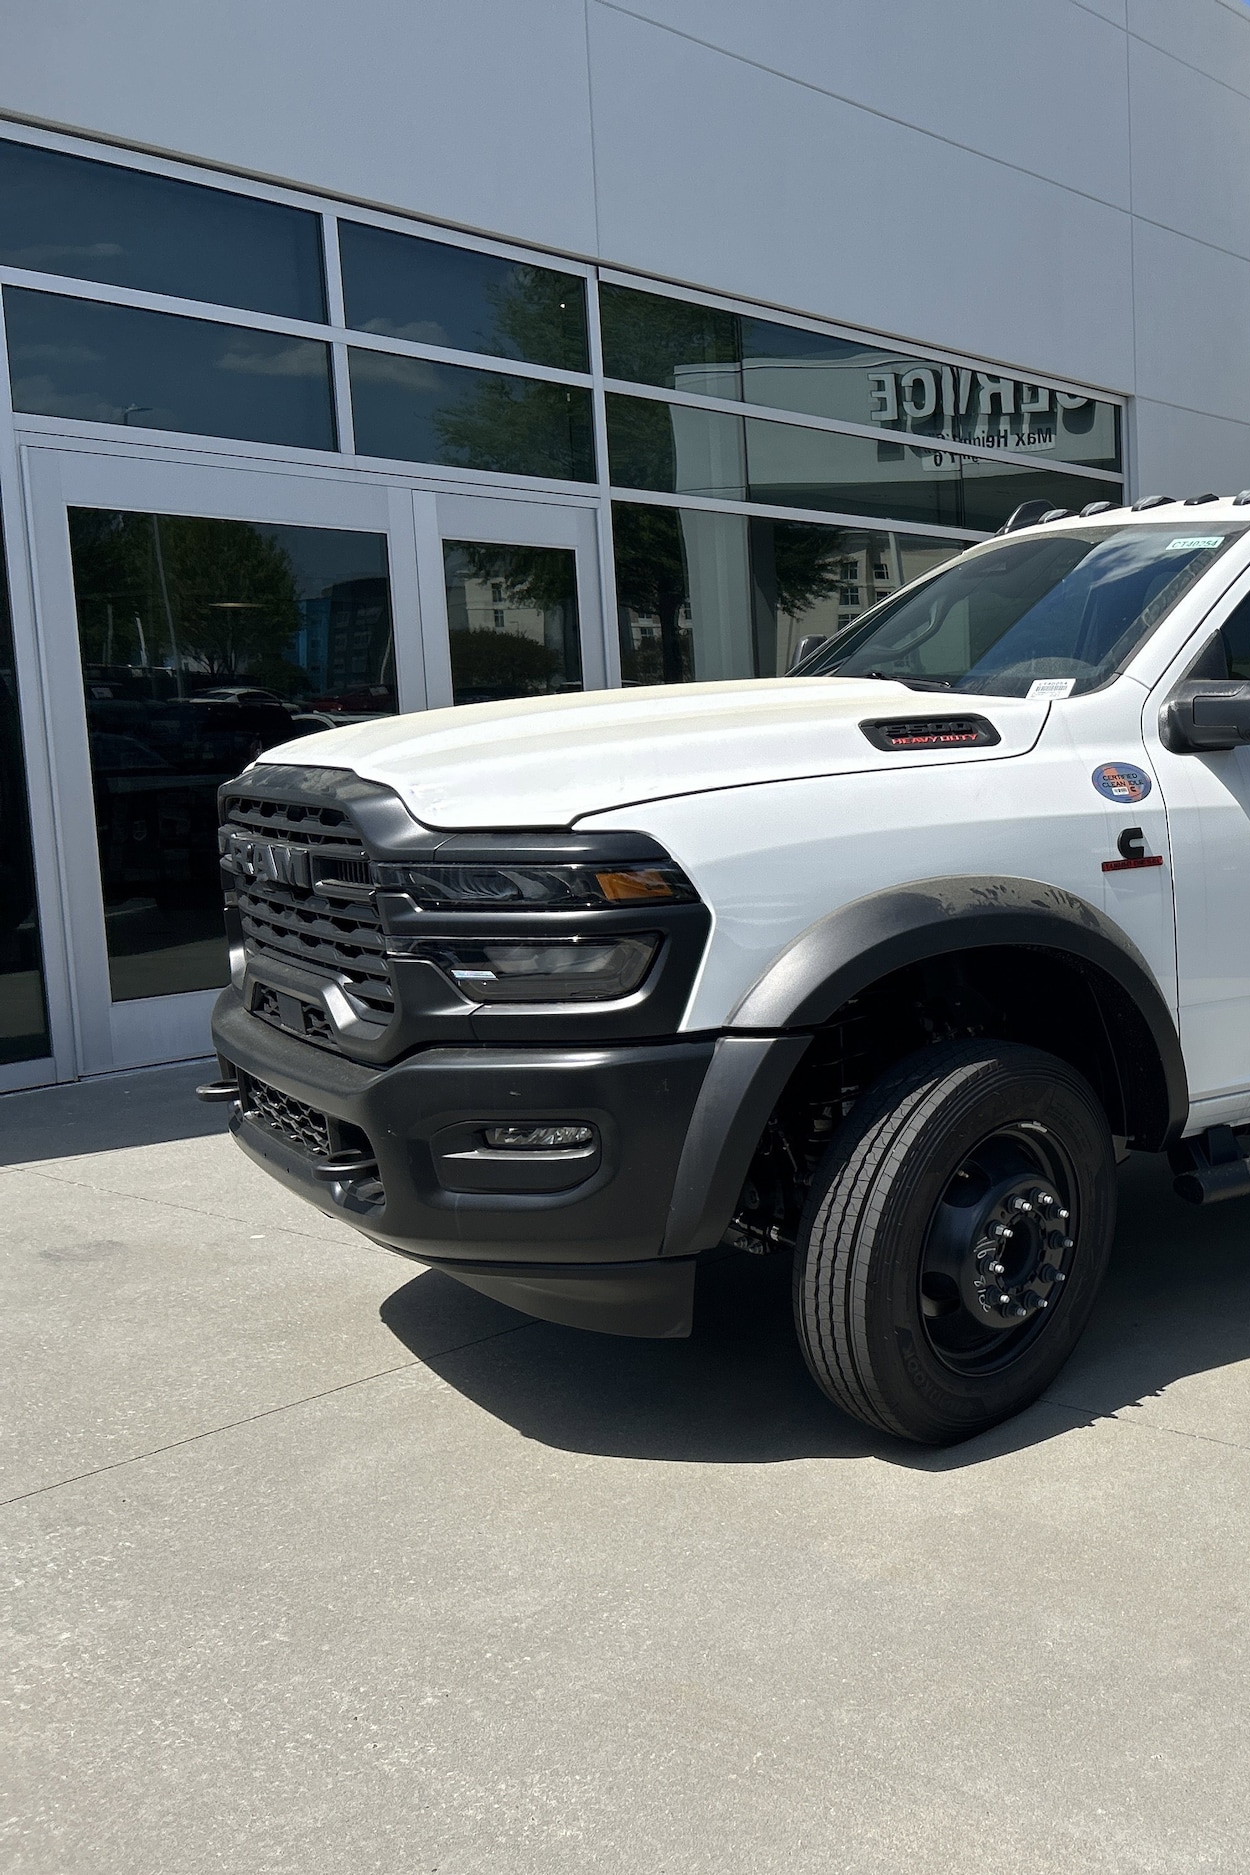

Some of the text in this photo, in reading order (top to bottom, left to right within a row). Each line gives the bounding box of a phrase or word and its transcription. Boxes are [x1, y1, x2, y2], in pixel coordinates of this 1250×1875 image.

[891, 733, 978, 745] HEAVY DUTY
[1102, 773, 1138, 781] CERTIFIED
[230, 842, 310, 888] RAM
